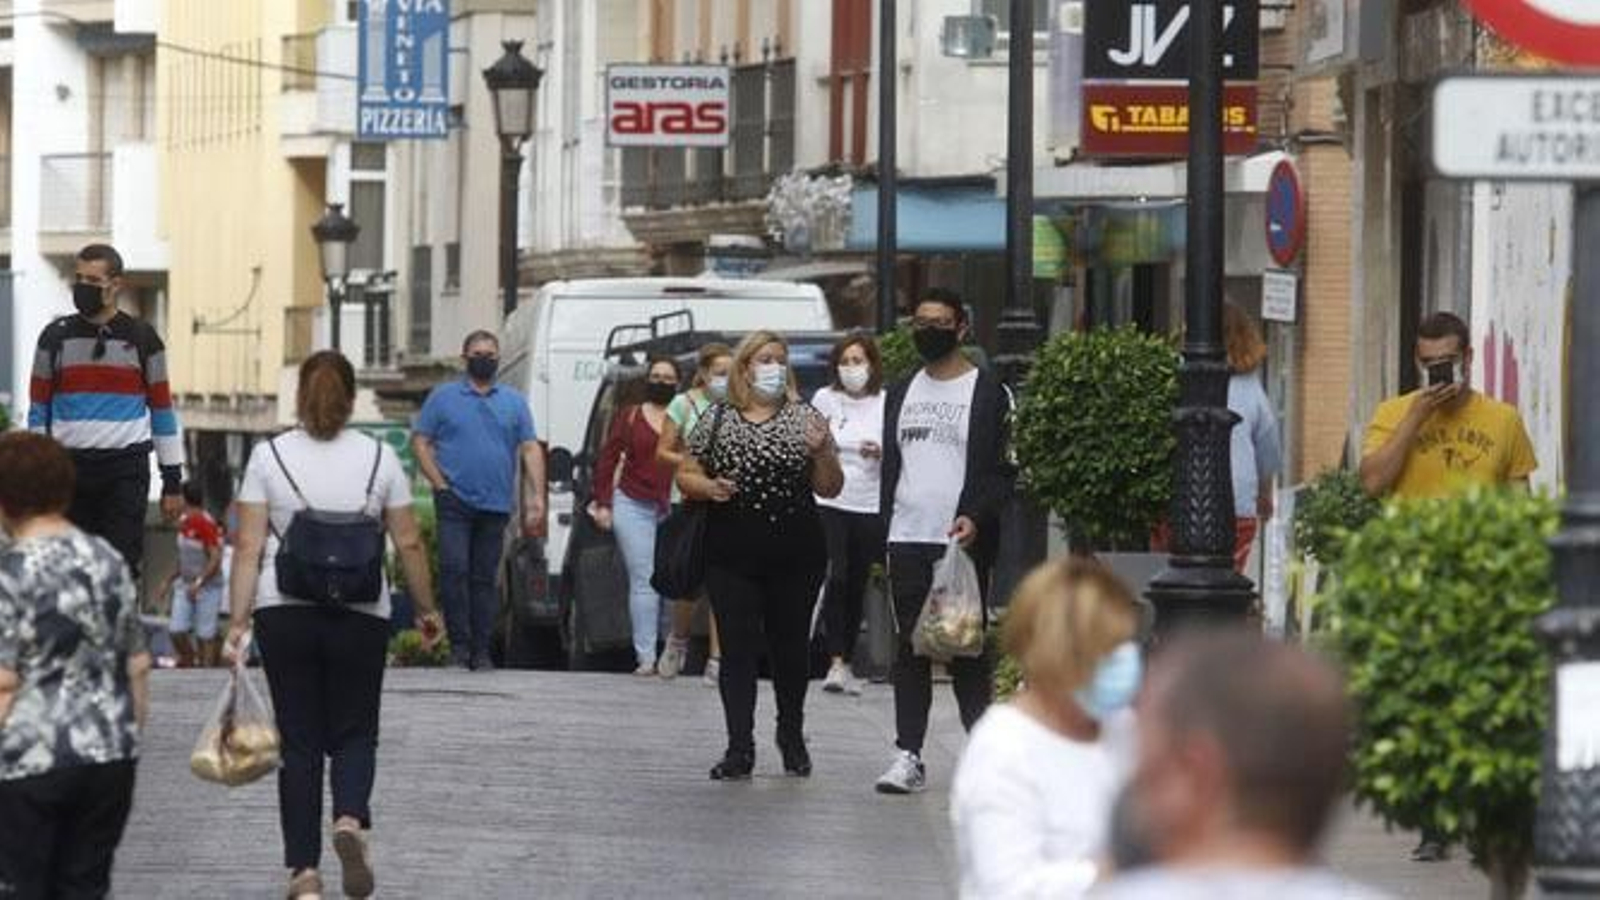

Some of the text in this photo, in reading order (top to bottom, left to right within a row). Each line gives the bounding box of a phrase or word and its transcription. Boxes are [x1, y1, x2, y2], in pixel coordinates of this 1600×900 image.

[1107, 4, 1235, 67] JV
[611, 76, 726, 90] GESTORIA
[611, 101, 726, 134] aras
[1126, 106, 1248, 125] TABAS
